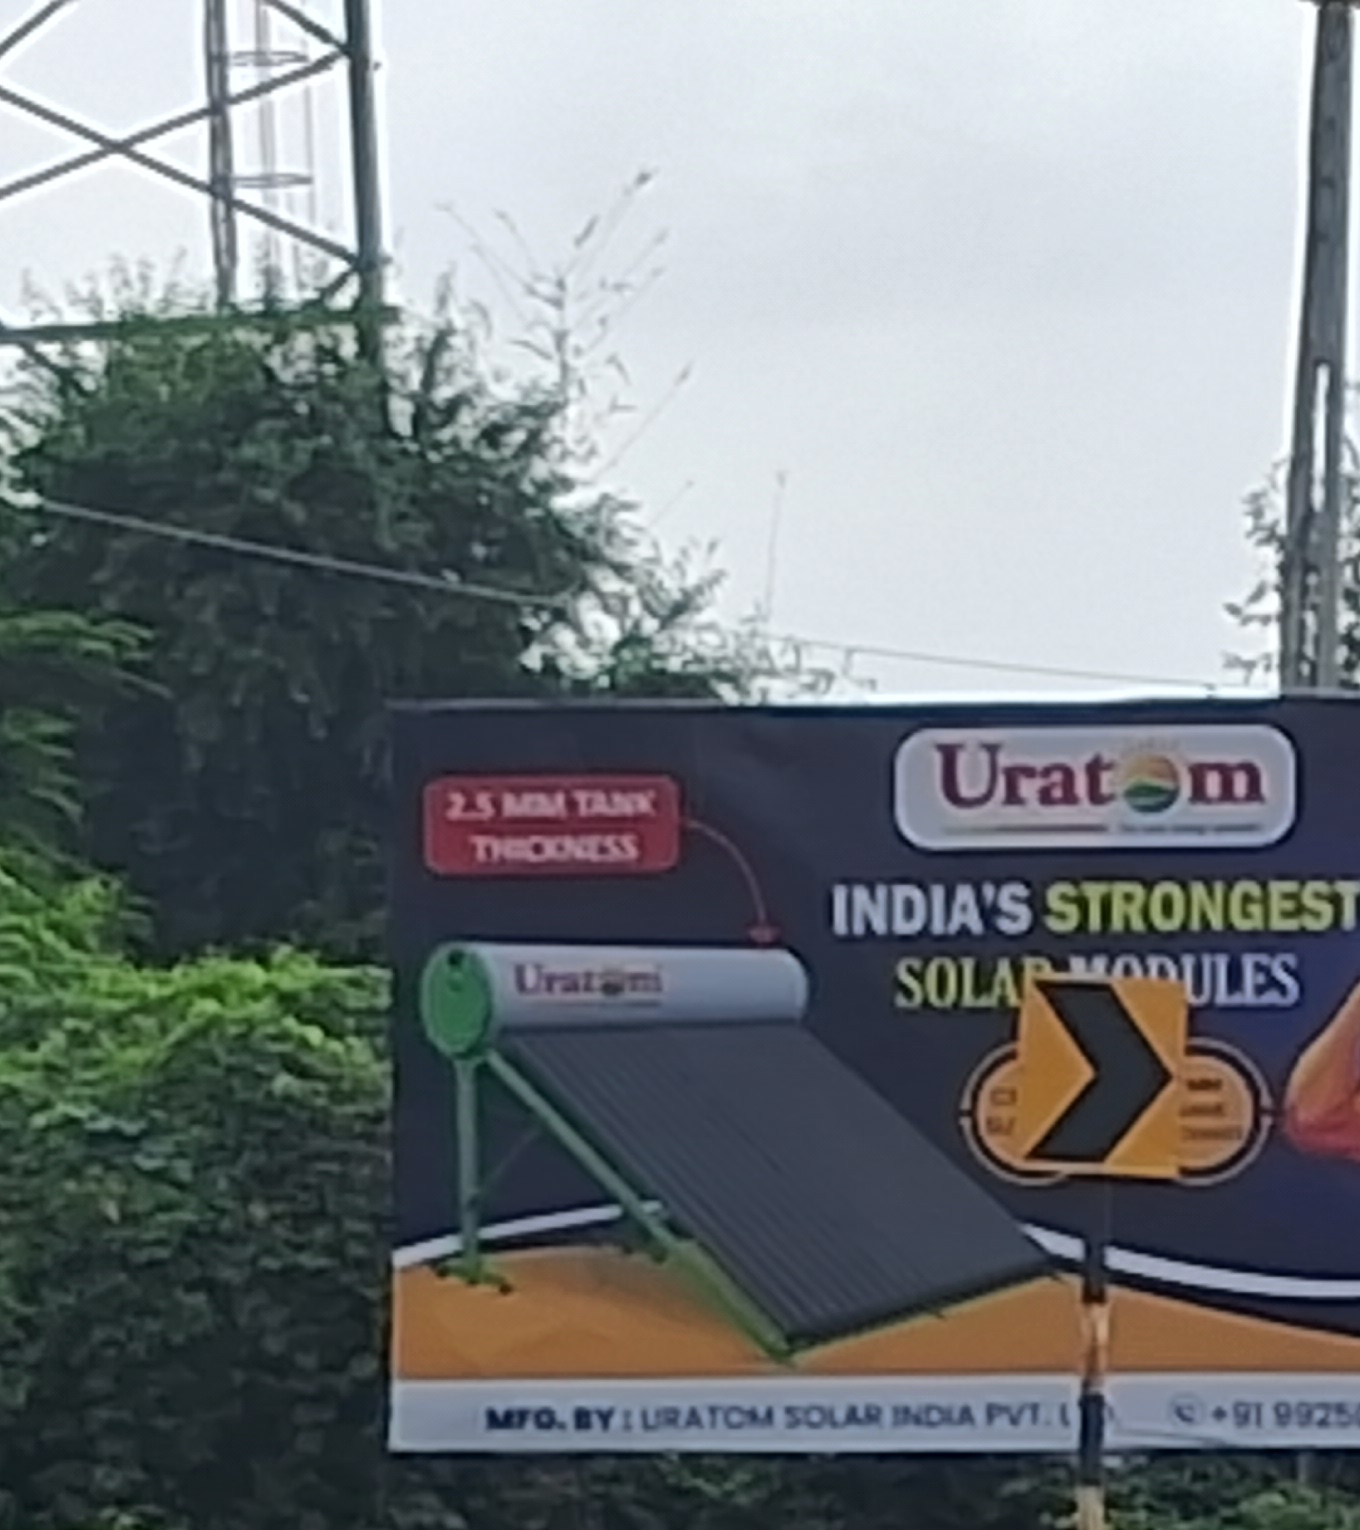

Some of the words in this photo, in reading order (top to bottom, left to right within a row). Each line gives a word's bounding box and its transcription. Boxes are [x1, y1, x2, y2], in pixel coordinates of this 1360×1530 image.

[935, 742, 1267, 810] Uratom
[446, 792, 495, 821] 2.5
[502, 790, 568, 819] MM
[574, 788, 657, 817] TANK
[470, 834, 639, 863] THICKNESS
[832, 882, 1033, 936] INDIA'S
[484, 1406, 567, 1431] MFG.
[574, 1406, 615, 1431] BY
[641, 1404, 774, 1430] URATOM
[784, 1404, 882, 1429] SOLAR
[892, 1403, 975, 1428] INDIA
